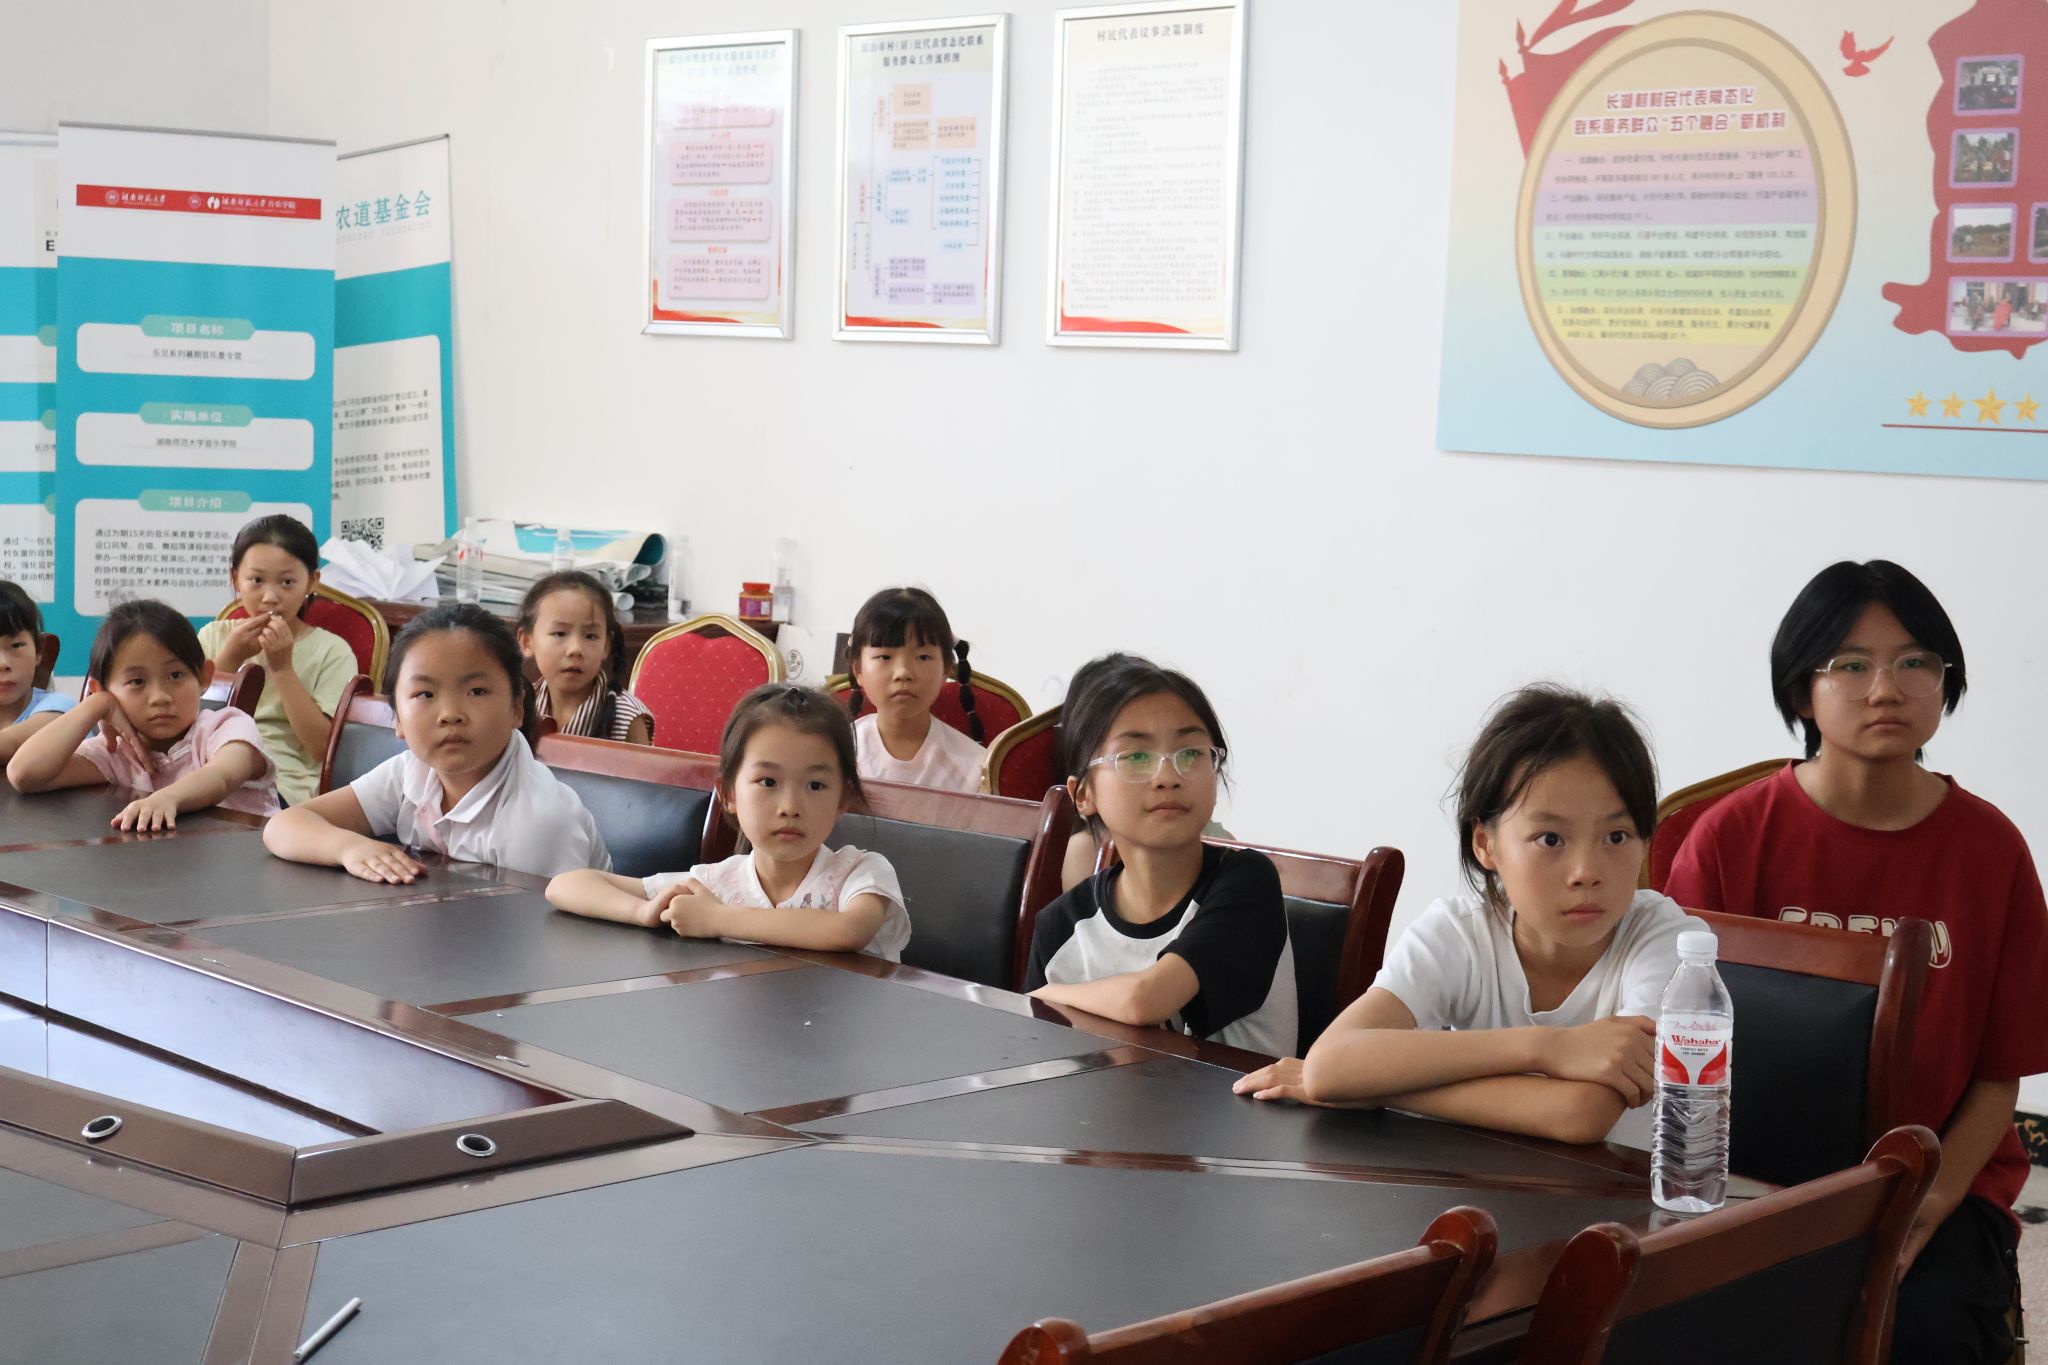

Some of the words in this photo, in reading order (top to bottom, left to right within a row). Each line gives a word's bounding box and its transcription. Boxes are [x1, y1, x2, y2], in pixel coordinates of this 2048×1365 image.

[336, 190, 431, 230] 农道基金会
[170, 322, 224, 335] 项目名称
[170, 409, 223, 423] 实施单位
[168, 495, 222, 509] 项目介绍
[1671, 1034, 1720, 1047] Wahaha
